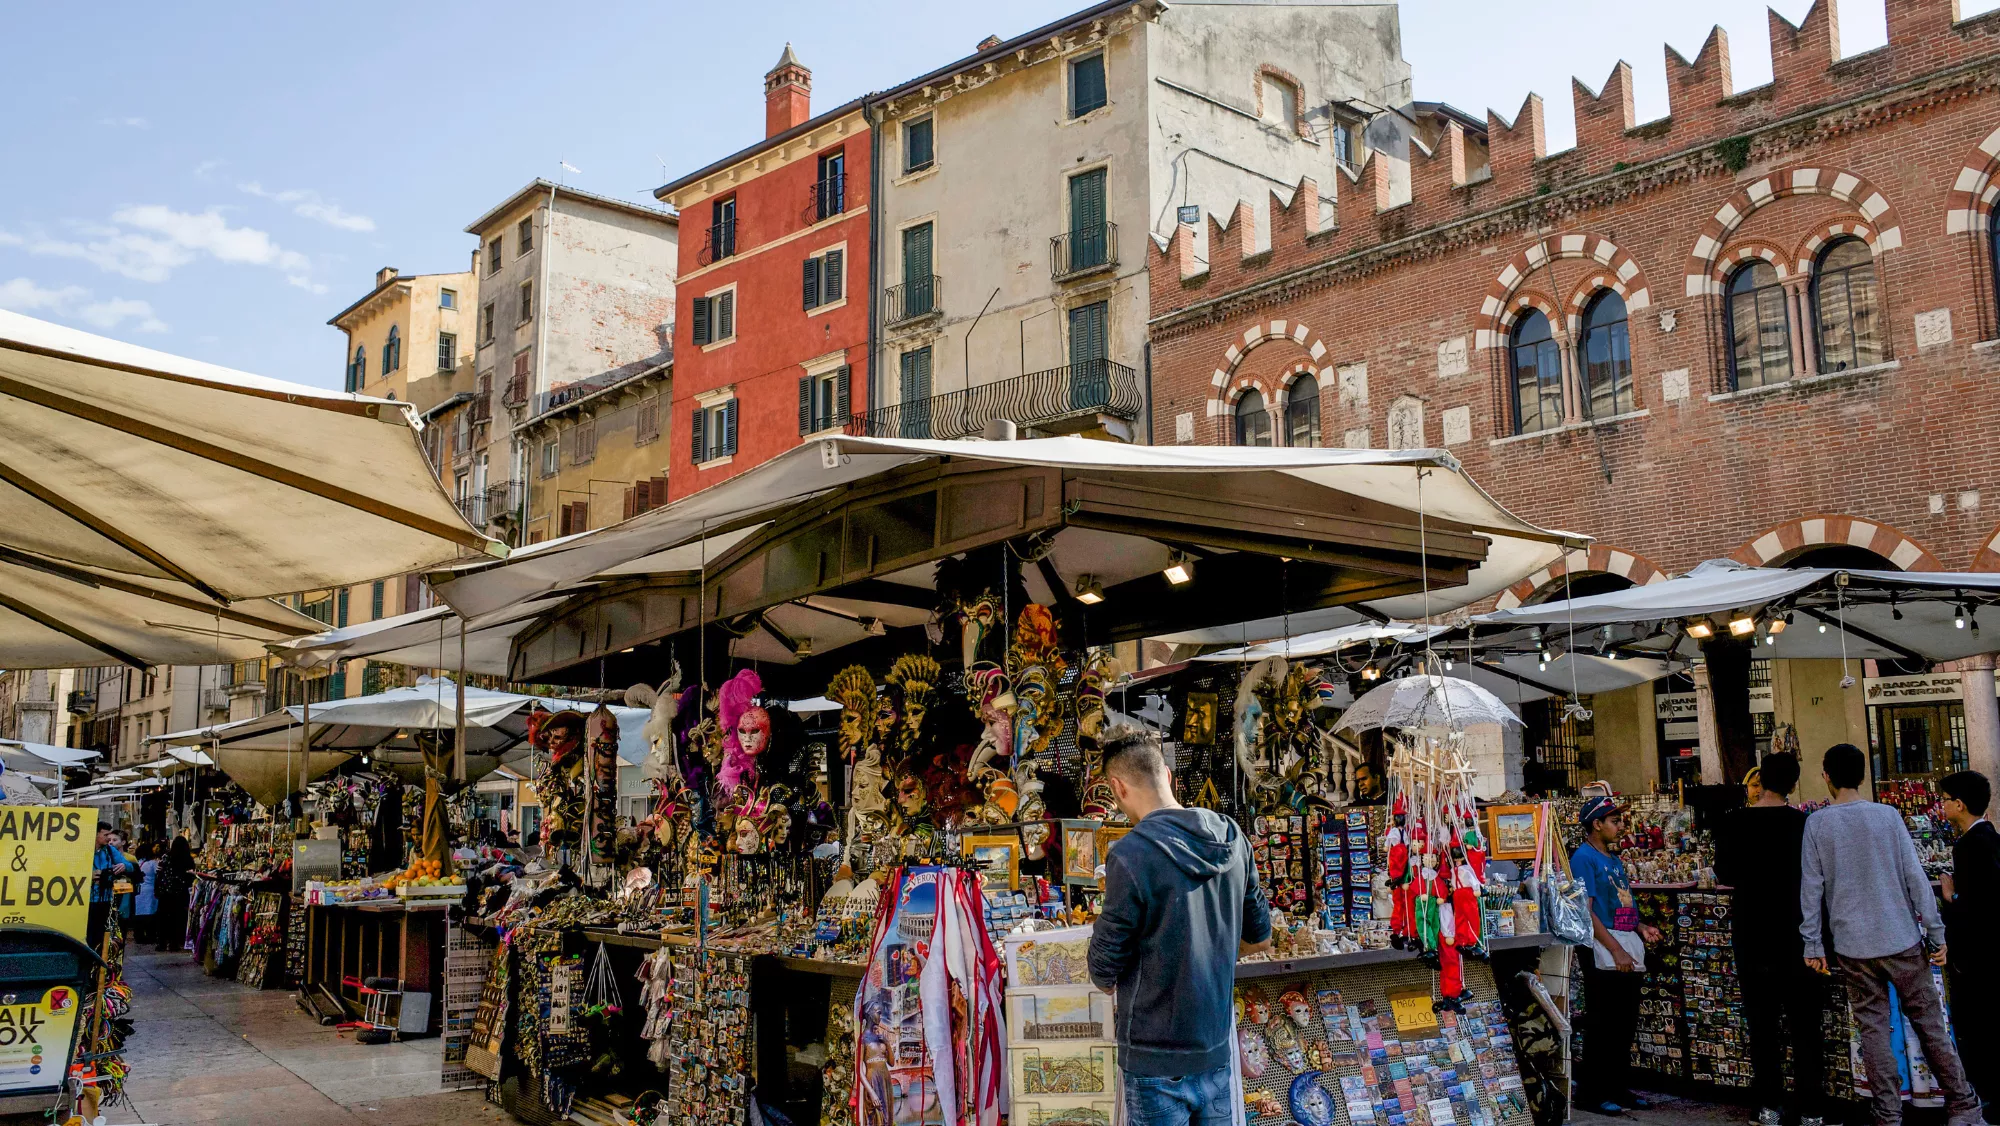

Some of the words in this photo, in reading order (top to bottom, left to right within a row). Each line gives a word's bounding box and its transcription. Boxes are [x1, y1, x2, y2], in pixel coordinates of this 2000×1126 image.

[1882, 680, 1929, 689] BANCA
[1899, 686, 1955, 696] VERONA
[0, 810, 81, 842] AMPS
[11, 844, 28, 873] &
[26, 875, 87, 907] BOX
[2, 916, 26, 924] GPS
